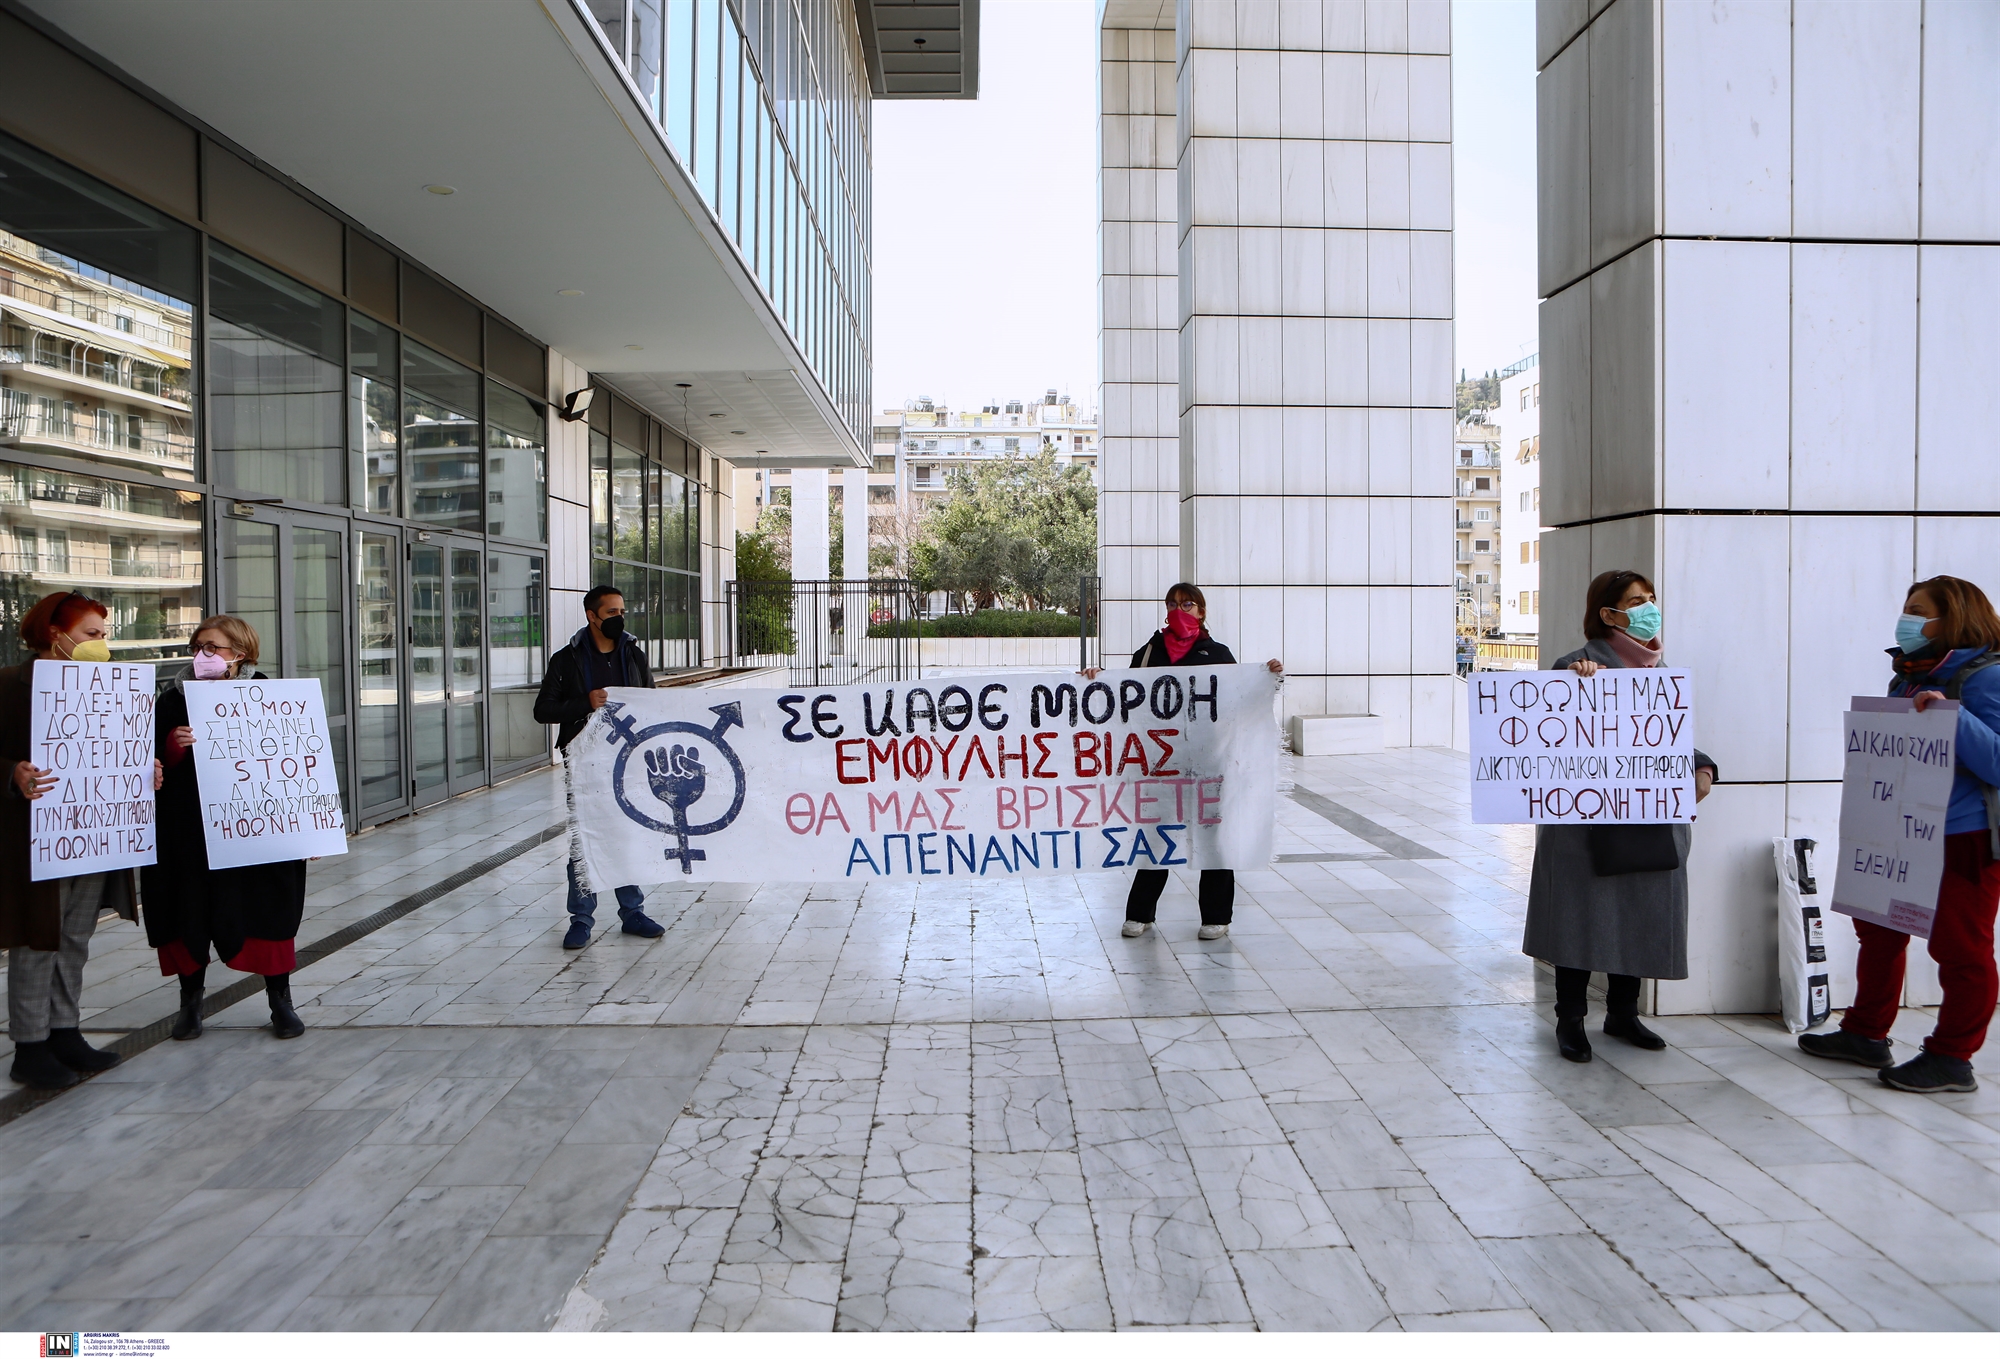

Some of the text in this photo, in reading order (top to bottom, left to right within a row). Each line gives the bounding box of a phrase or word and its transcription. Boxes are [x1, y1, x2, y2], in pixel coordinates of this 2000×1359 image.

[62, 665, 140, 692] ΠΑΡΕ
[40, 691, 156, 714] ΤΗ ΛΕΞΗ ΜΟΥ
[233, 685, 263, 702] ΤΟ
[1478, 676, 1688, 714] Η ΦΩΝΗ ΜΑΣ
[261, 700, 306, 716] ΜΟΥ
[777, 674, 1218, 743] ΣΕ ΚΑΘΕ ΜΟΡΦΗ
[46, 713, 152, 740] ΔΩΣΕ ΜΟΥ
[205, 717, 315, 740] ΣΗΜΑΙΝΕΙ
[1499, 713, 1685, 748] ΦΩΝΗ ΣΟΥ
[40, 742, 69, 770] ΤΟ
[260, 735, 324, 756] ΘΕΛΩ
[835, 729, 1180, 784] ΕΜΦΥΛΗΣ ΒΙΑΣ
[234, 755, 317, 782] STOP
[1615, 755, 1695, 780] ΣΥΓΓΡΑΦΕΩΝ
[62, 774, 143, 803] ΔΙΚΤΥΟ
[232, 778, 319, 800] ΔΙΚΤΥΟ
[1872, 781, 1893, 801] ΓΙΑ
[209, 798, 285, 821] ΓΥΝΑΙΚΩΝ
[785, 777, 1224, 836] ΘΑ ΜΑΣ ΒΡΙΣΚΕΤΕ
[236, 813, 300, 838] ΦΩΝΗ
[1903, 815, 1935, 841] ΤΗΝ
[55, 831, 109, 860] ΦΩΝΗ
[845, 824, 1187, 876] ΑΠΕΝΑΝΤΙ ΣΑΣ
[1854, 849, 1908, 883] ΕΛΕΝΗ
